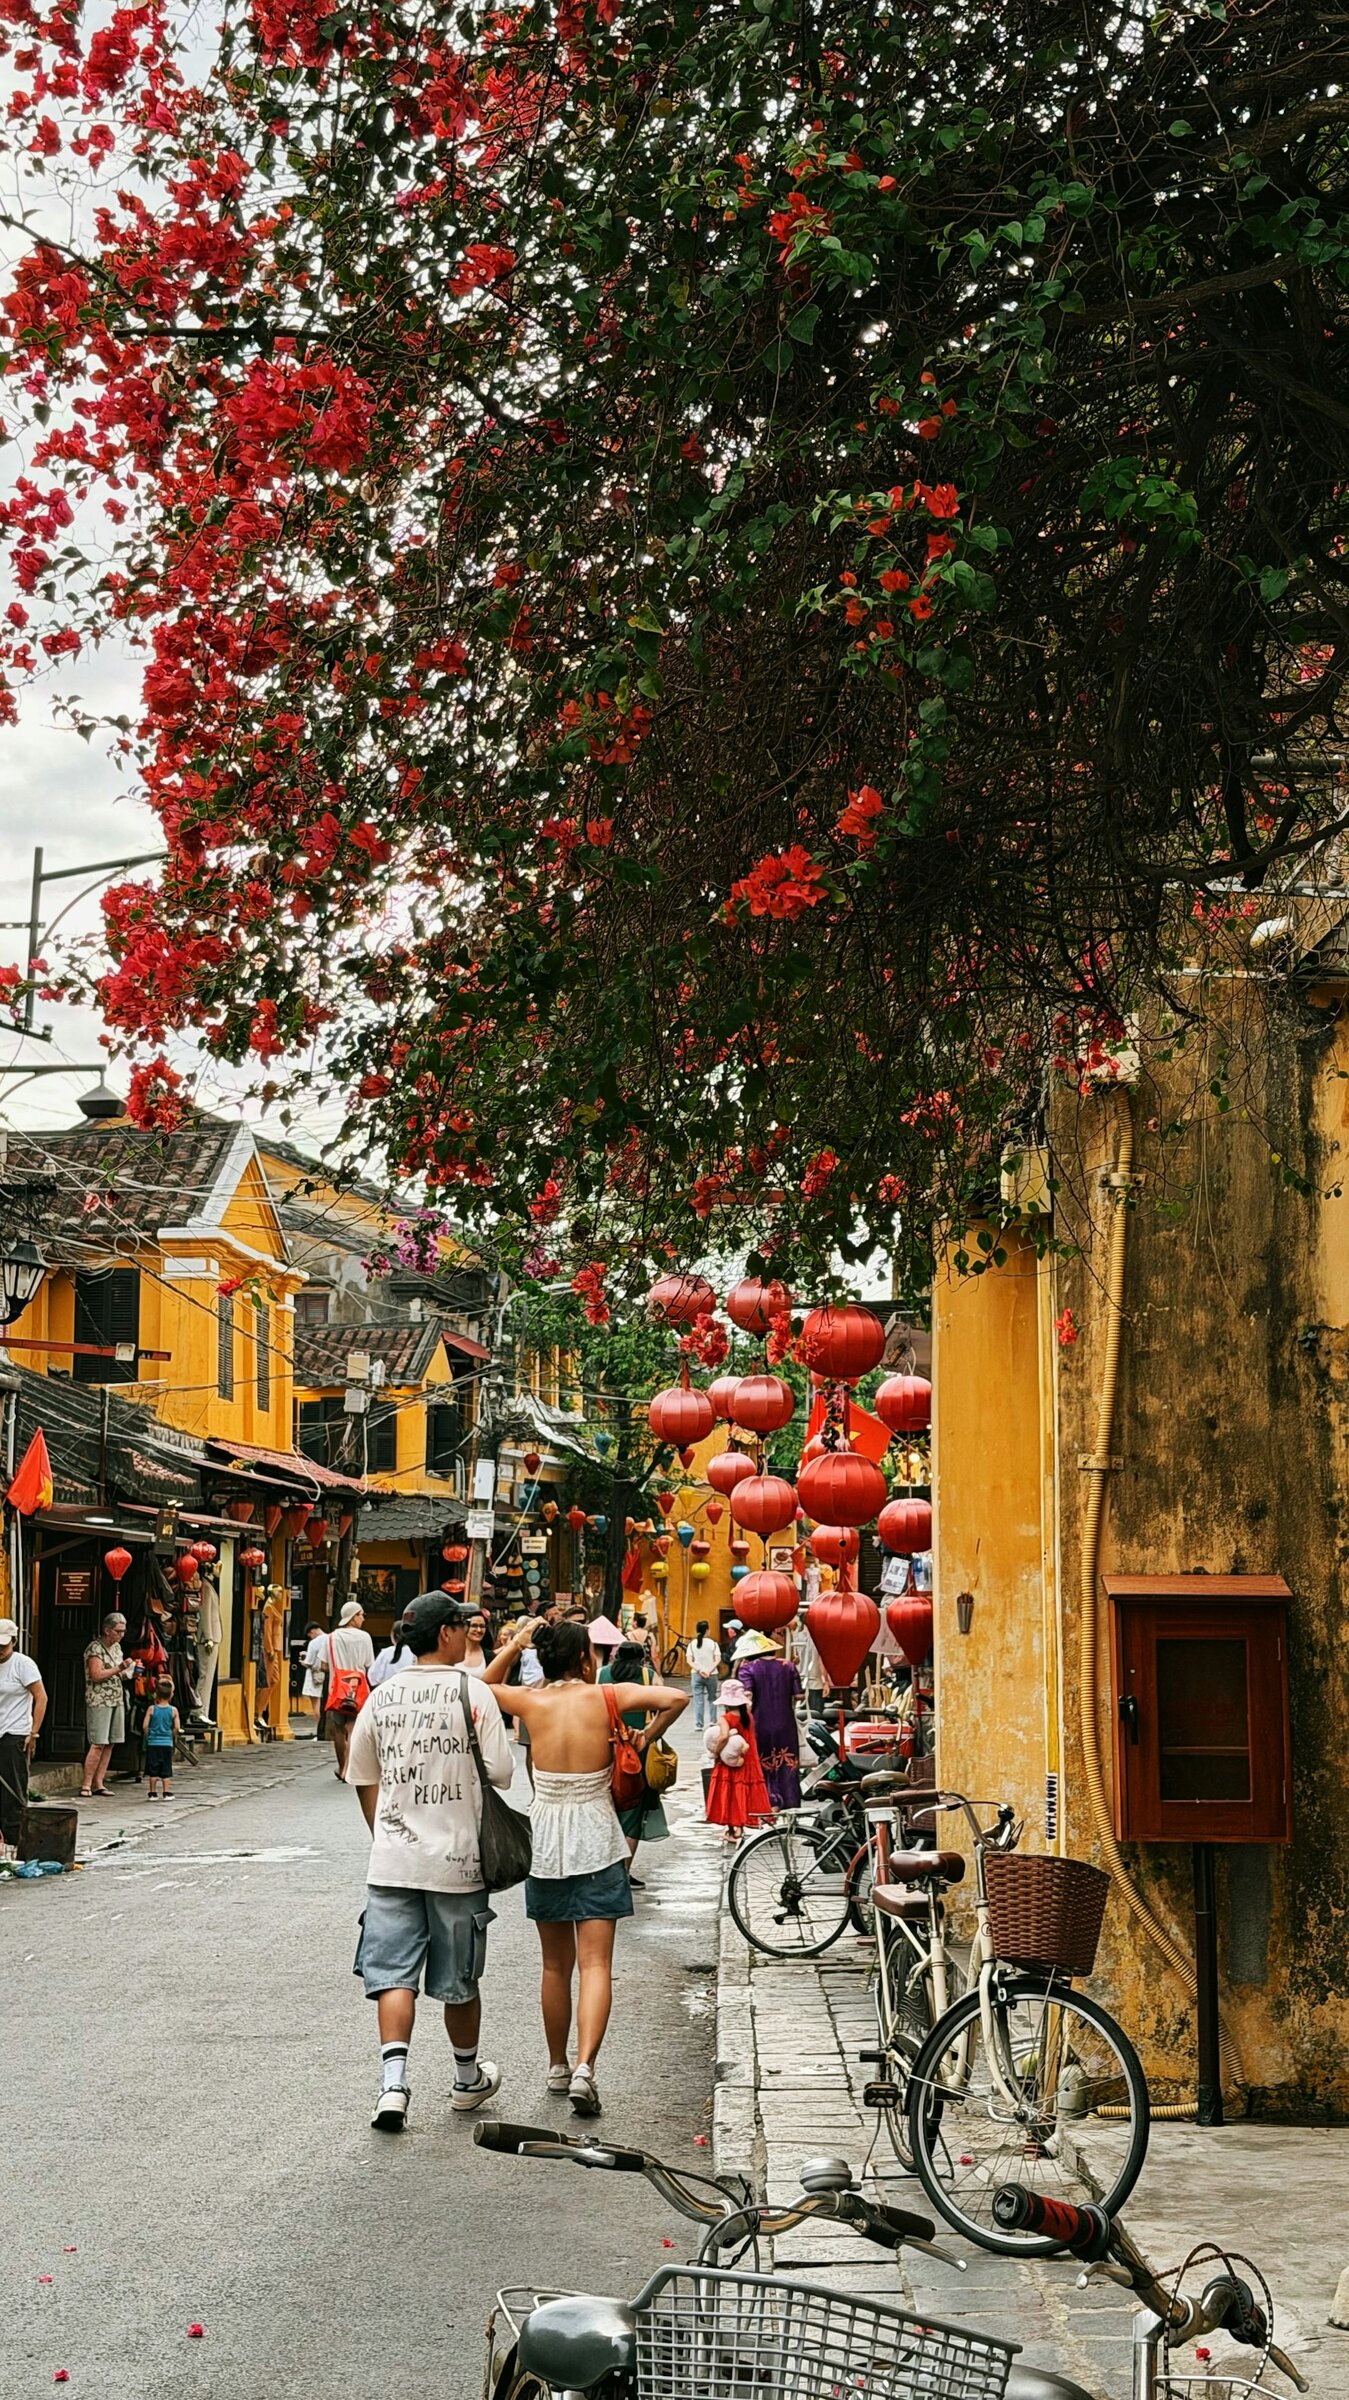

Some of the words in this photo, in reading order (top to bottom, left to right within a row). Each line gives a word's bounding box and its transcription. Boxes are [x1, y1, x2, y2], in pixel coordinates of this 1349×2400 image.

[412, 1684, 441, 1704] WAIT
[411, 1710, 436, 1729] TIME
[415, 1784, 463, 1805] PEOPLE
